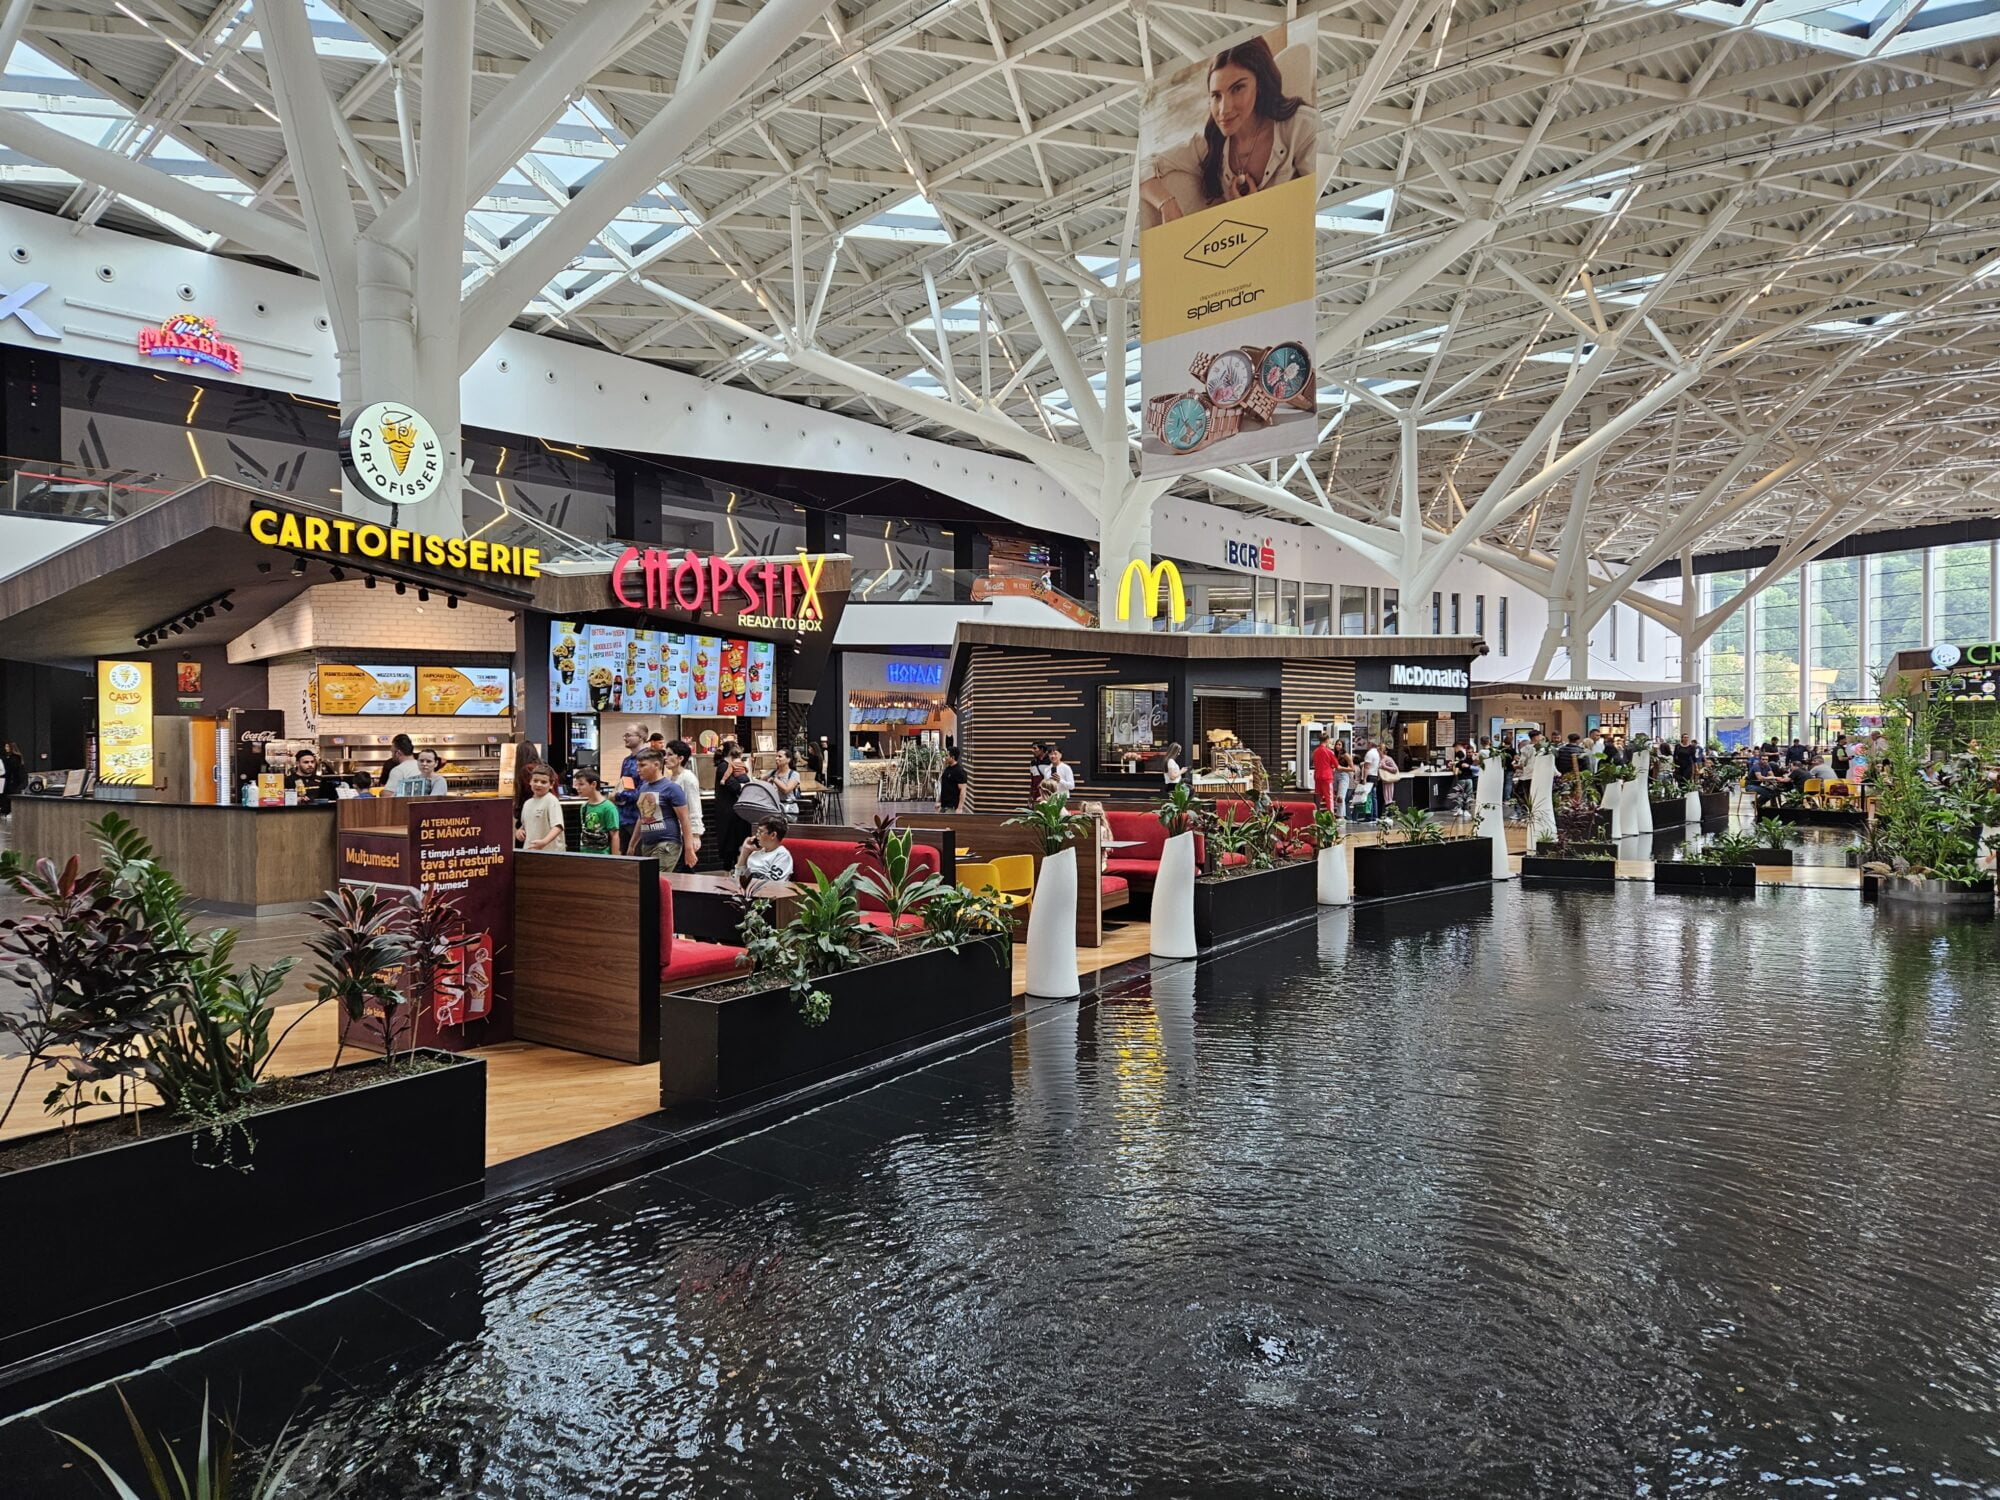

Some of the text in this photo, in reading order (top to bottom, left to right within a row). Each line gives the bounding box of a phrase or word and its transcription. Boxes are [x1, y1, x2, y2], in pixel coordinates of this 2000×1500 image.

[1203, 233, 1247, 255] FOSSIL
[1187, 289, 1264, 320] splend'or
[142, 327, 237, 364] MAXBET
[359, 428, 437, 496] CARTOFISSERIE
[250, 509, 541, 578] CARTOFISSERIE
[1227, 540, 1258, 568] BCR
[612, 546, 825, 620] CHOPSTIX
[738, 614, 823, 632] READY TO BOX
[1391, 664, 1468, 688] McDonald's
[420, 817, 470, 828] AI TERMINAT
[421, 826, 481, 840] DE MÂNCAT?
[421, 844, 500, 860] E timpul să-mi aduci
[421, 860, 445, 870] tava
[460, 853, 504, 867] resturile
[421, 865, 488, 882] de mâncare!
[421, 879, 469, 893] Mlțumesc!
